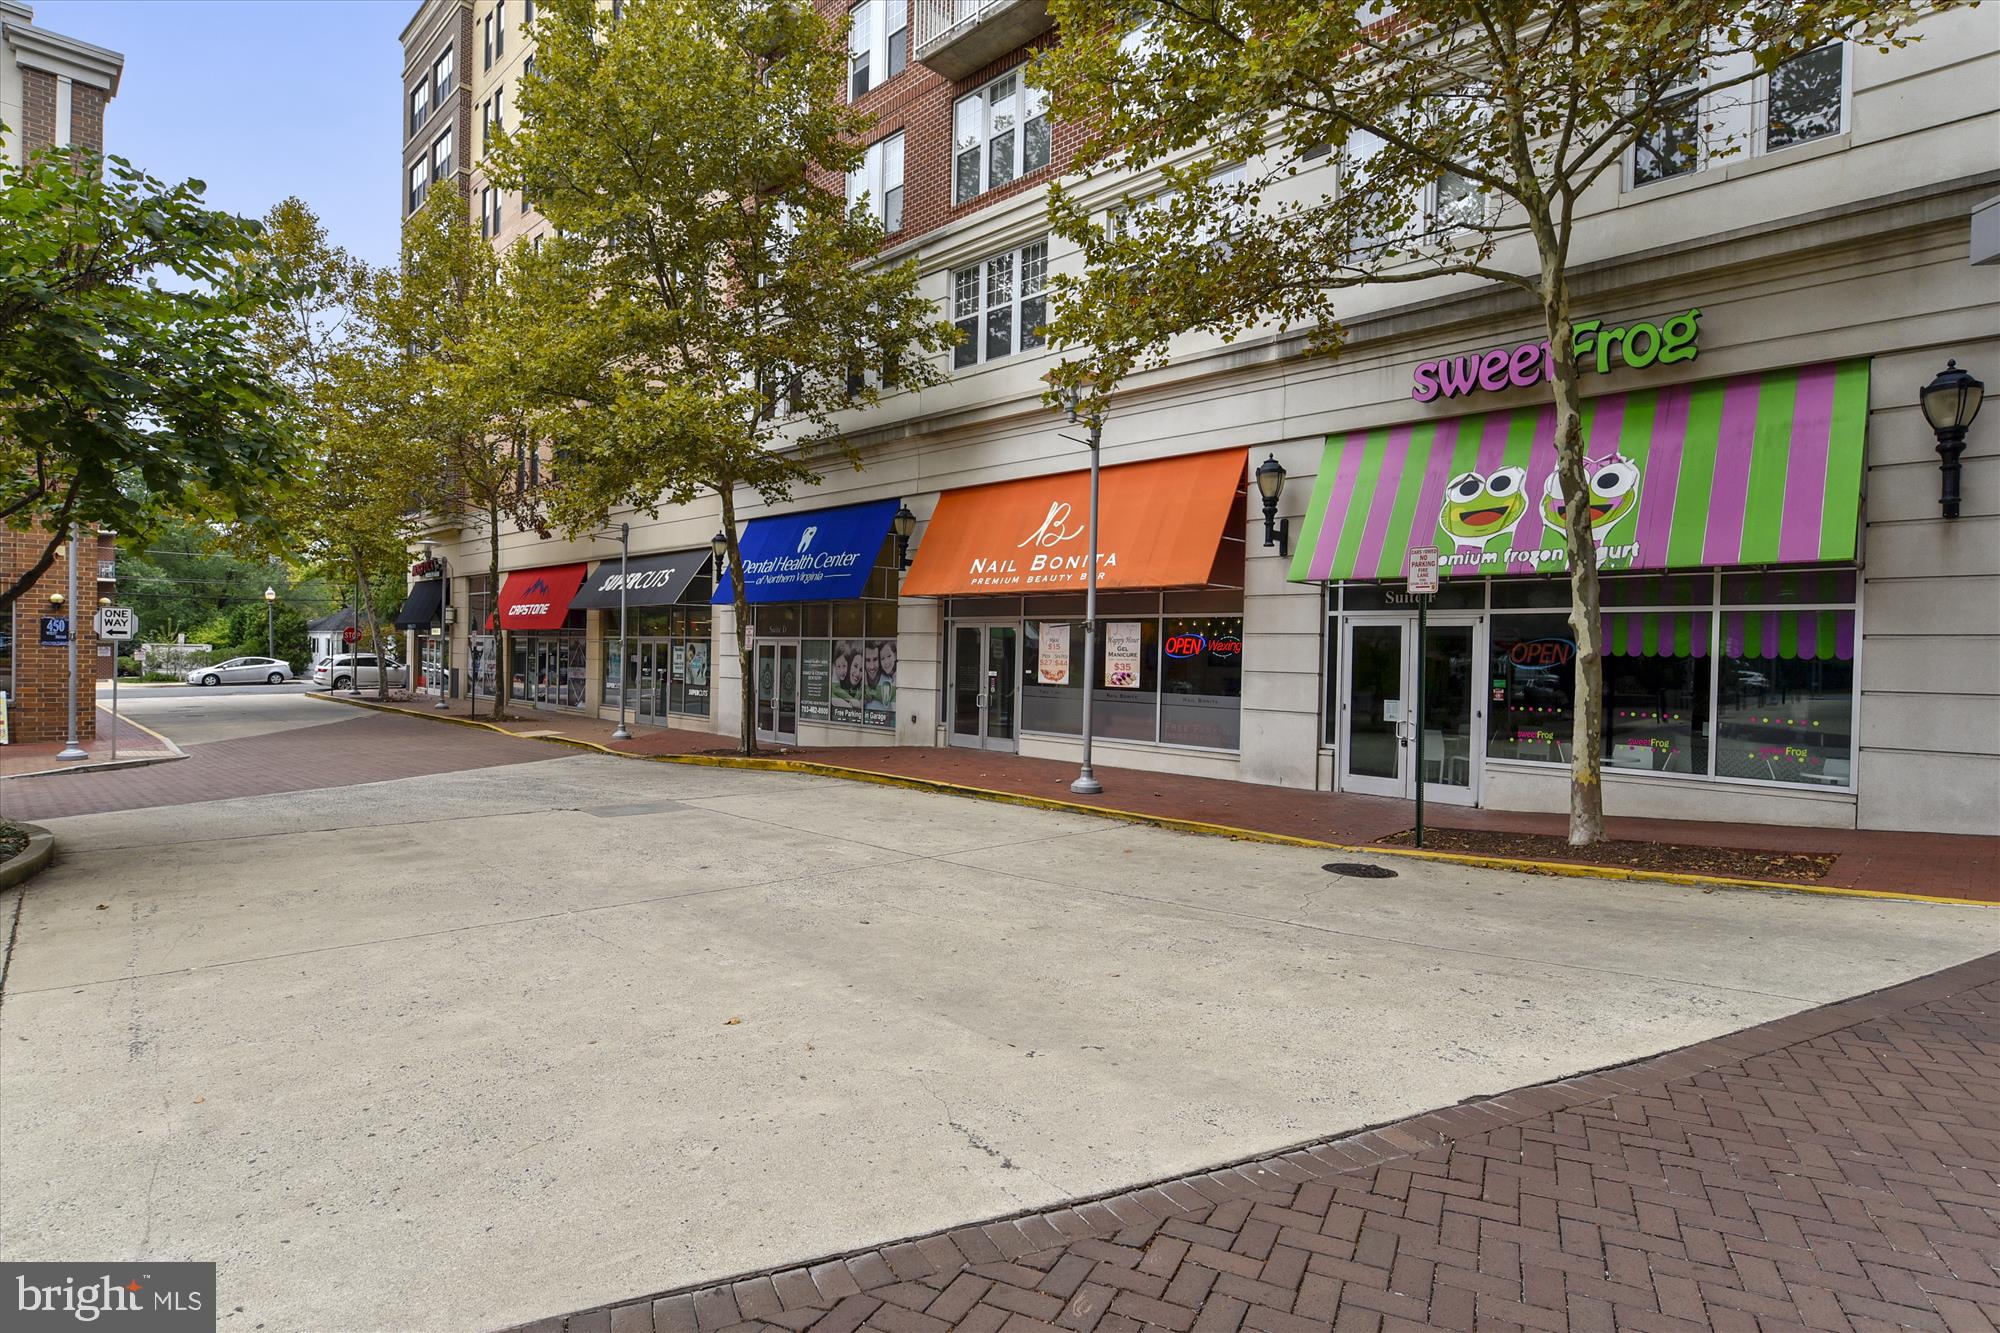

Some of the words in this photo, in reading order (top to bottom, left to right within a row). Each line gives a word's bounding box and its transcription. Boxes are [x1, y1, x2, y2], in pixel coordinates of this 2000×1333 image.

[1503, 547, 1563, 563] frozen
[742, 557, 778, 574] Dental
[775, 553, 814, 572] Health
[813, 551, 861, 569] Center
[755, 576, 767, 586] of
[764, 574, 796, 585] Northern
[796, 571, 825, 585] Virginia
[970, 576, 1020, 586] PREMIUM
[1026, 573, 1073, 584] BEAUTY
[1079, 572, 1106, 581] BR
[104, 609, 129, 618] ONE
[508, 603, 551, 616] CAPSTONE
[46, 619, 66, 633] 450
[104, 618, 129, 627] WAY
[344, 631, 361, 639] STP
[1165, 637, 1202, 655] OPEN
[1208, 639, 1242, 654] Waxing
[1511, 642, 1570, 664] OPEN
[1114, 662, 1132, 671] $35
[834, 708, 844, 717] Free
[869, 711, 887, 722] Garage
